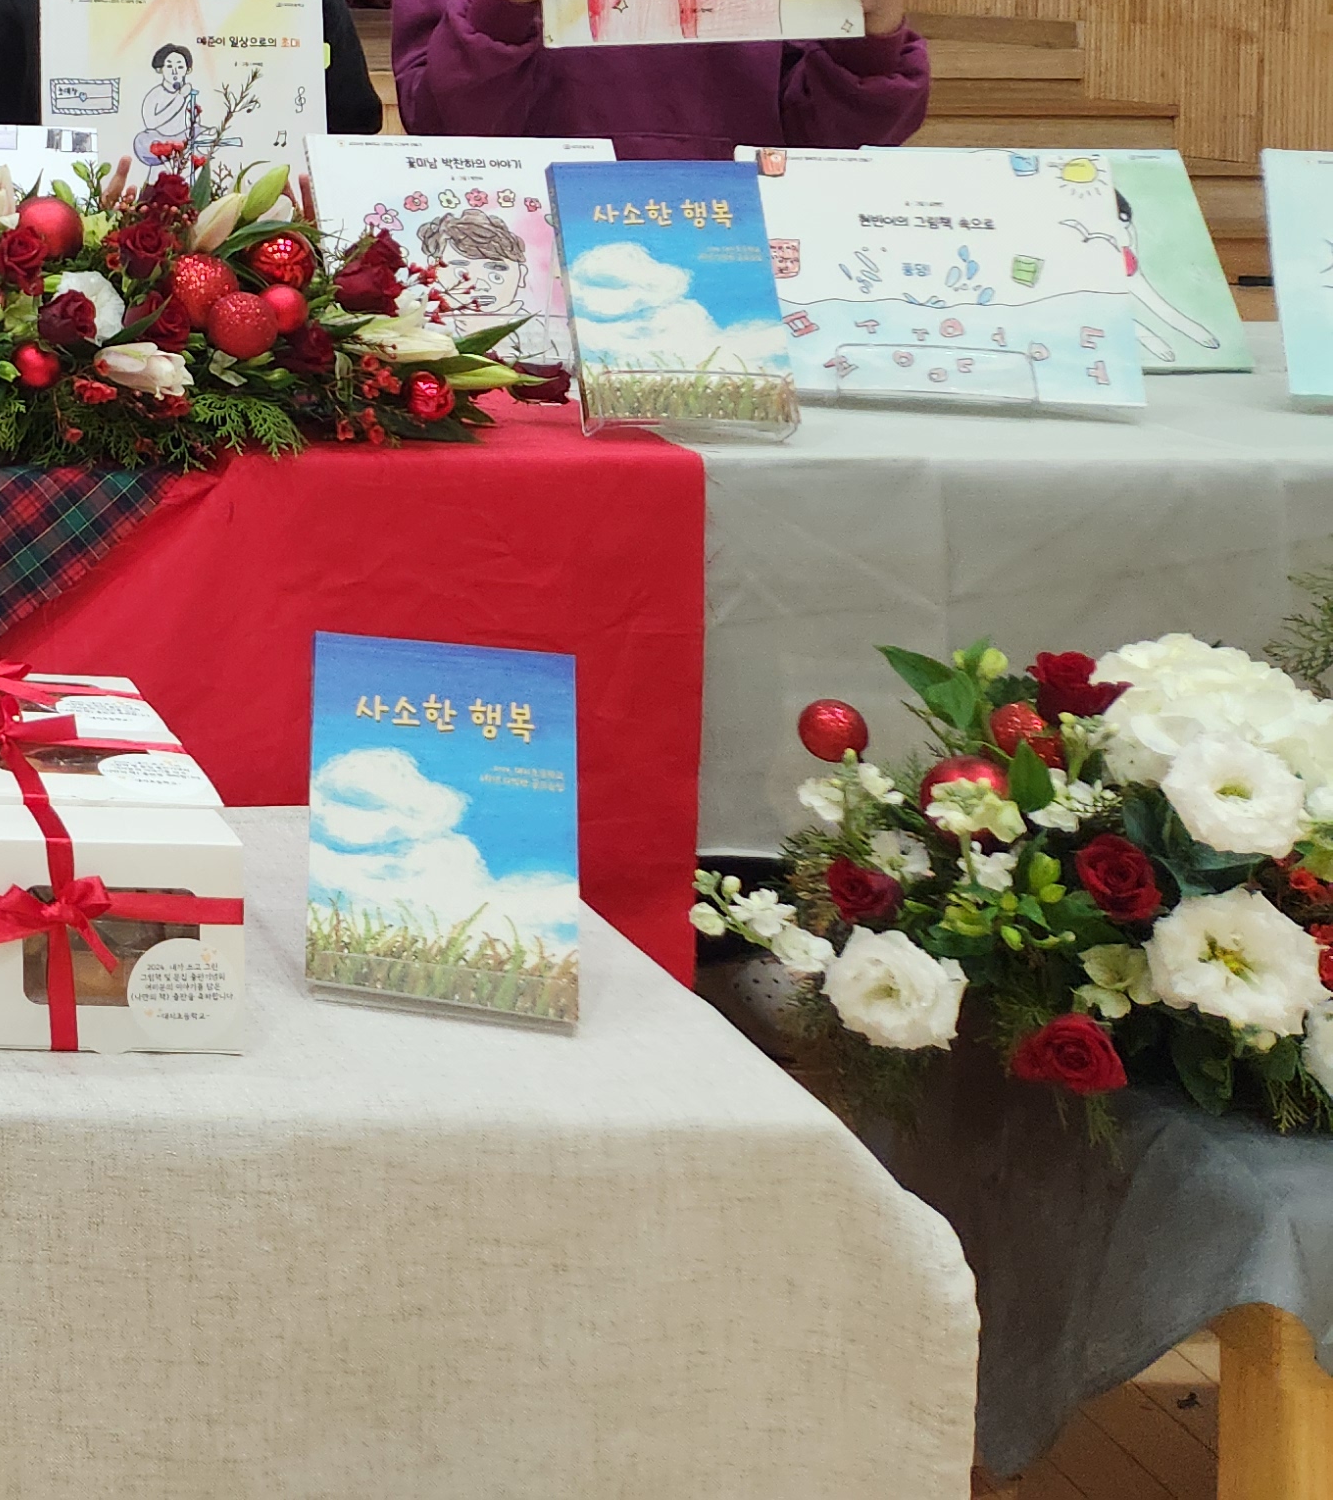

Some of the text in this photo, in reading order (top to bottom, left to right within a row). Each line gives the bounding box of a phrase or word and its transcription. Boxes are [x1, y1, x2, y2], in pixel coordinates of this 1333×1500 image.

[405, 157, 522, 170] 꽃미남 박찬하의 이야기
[593, 199, 733, 229] 사소한 행복
[914, 216, 953, 230] 그림책
[958, 216, 996, 231] 속으로
[355, 694, 535, 743] 사소한 행복
